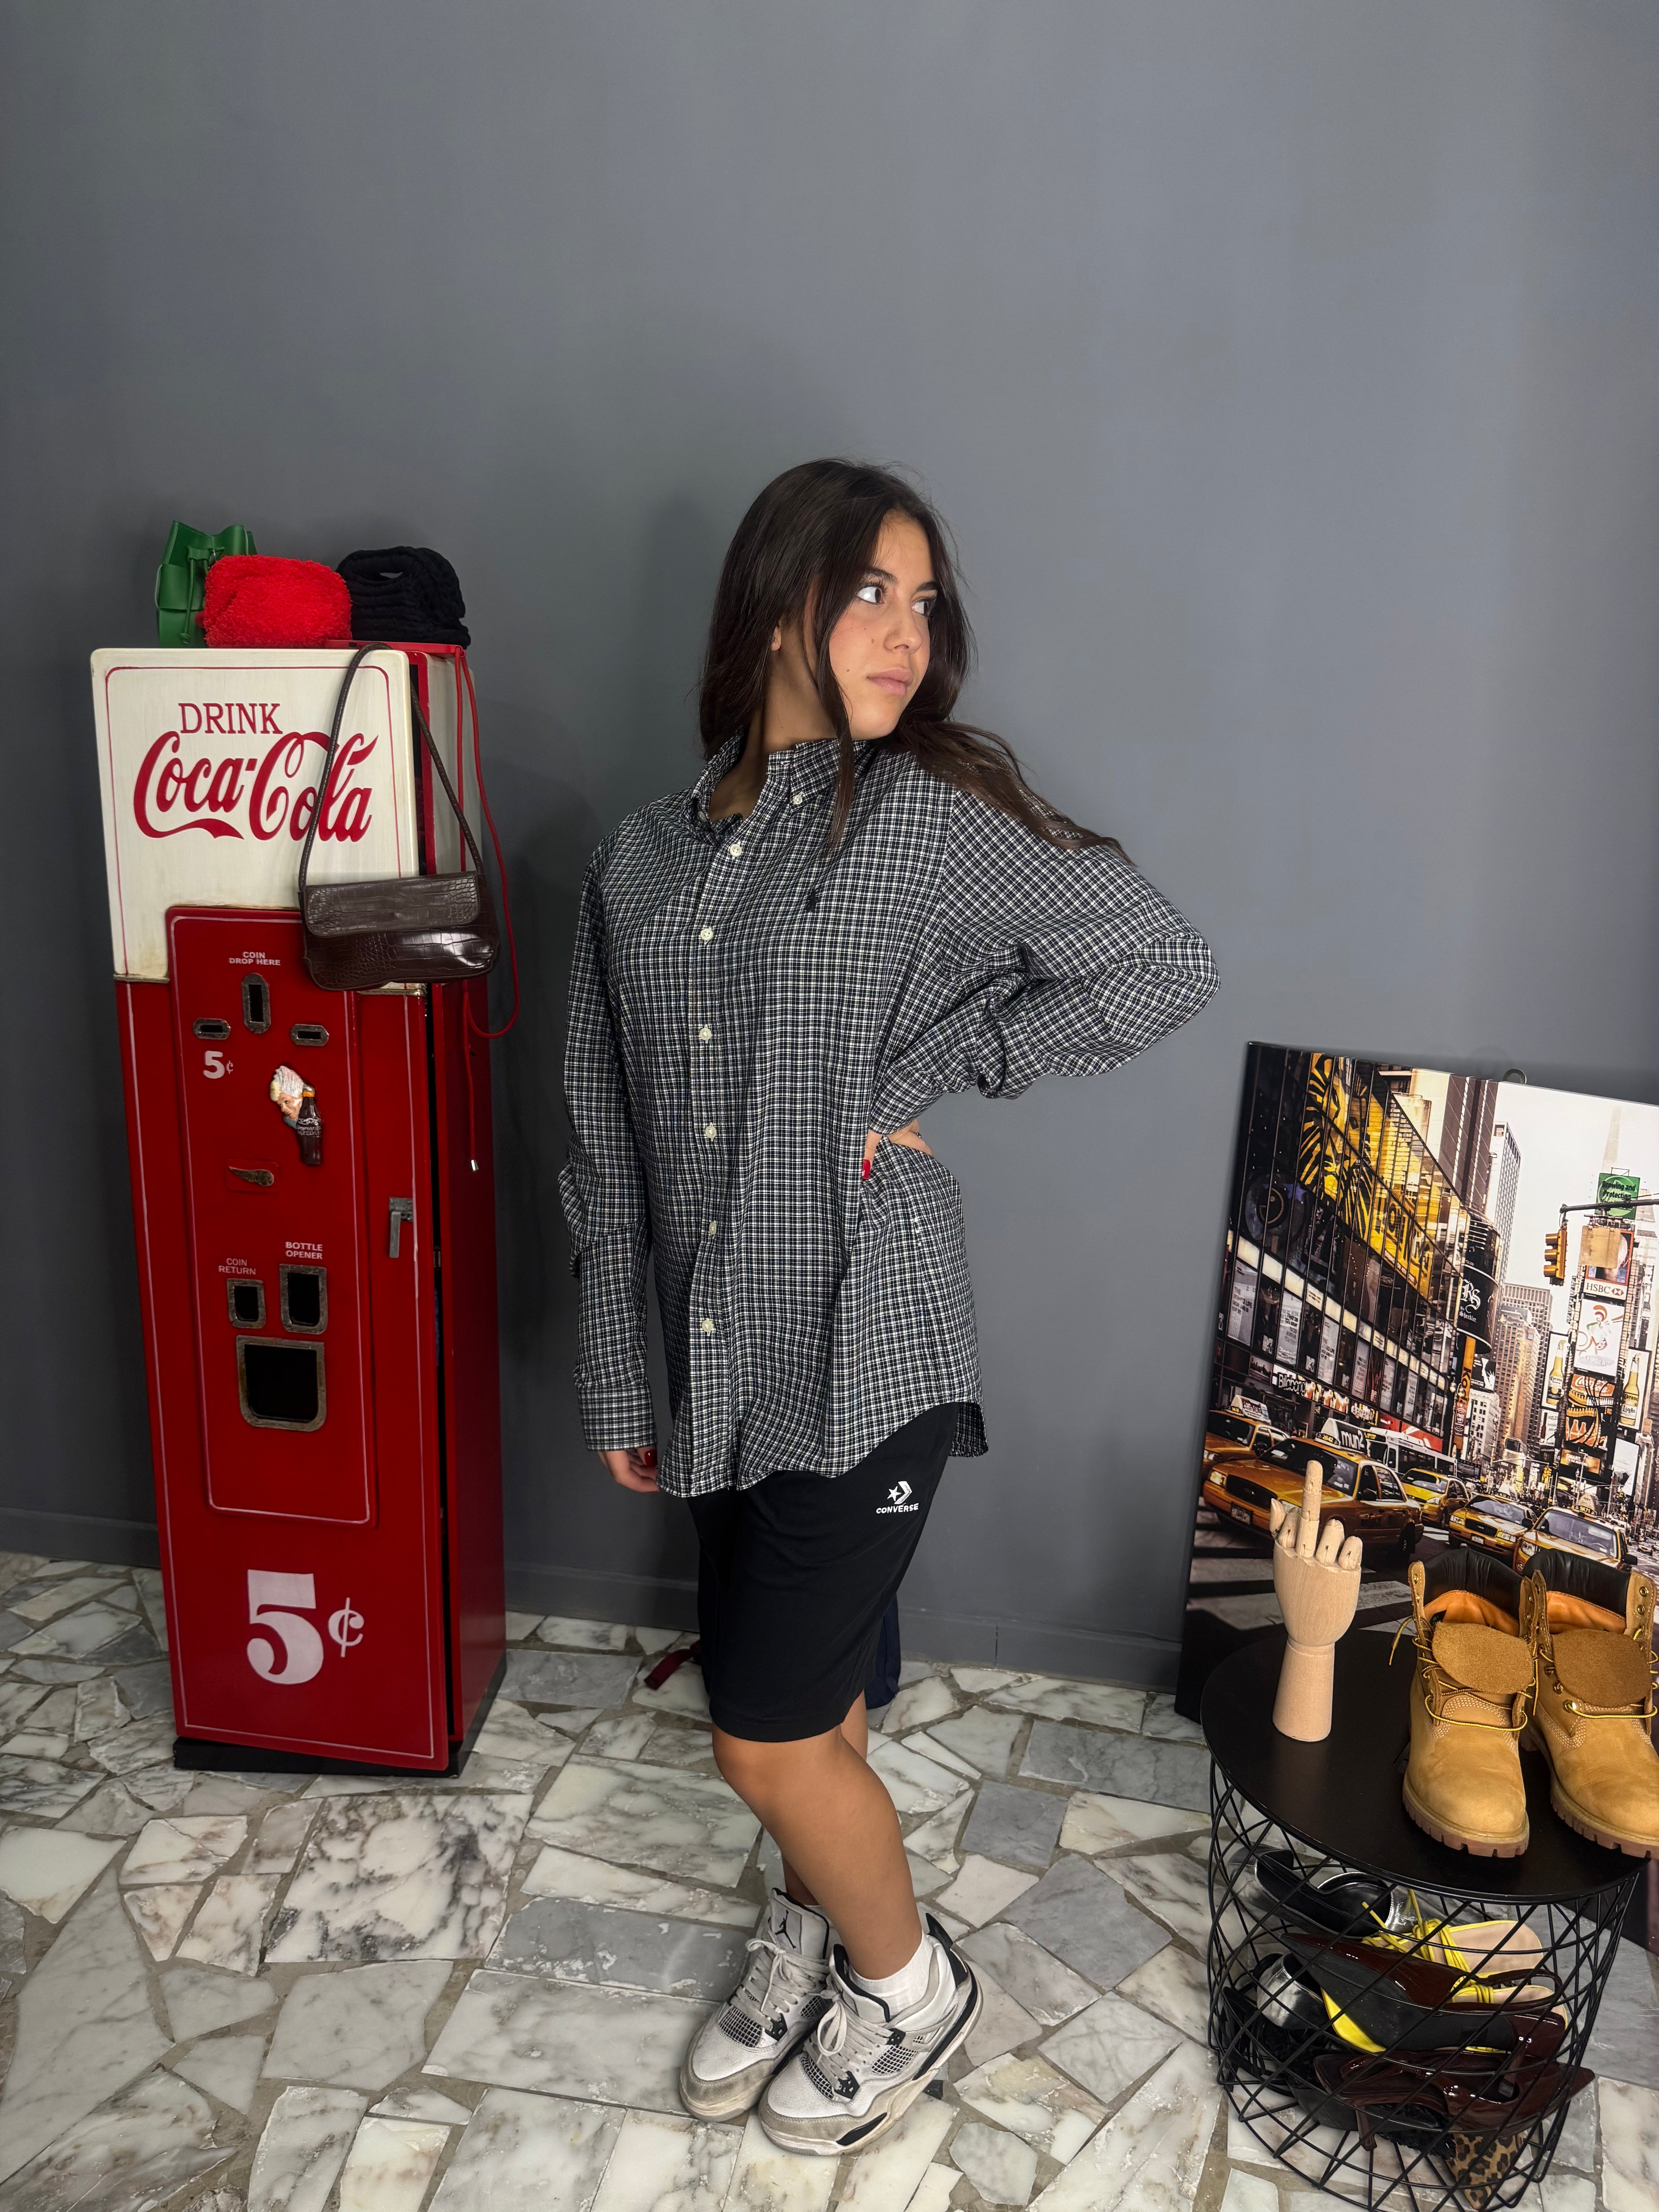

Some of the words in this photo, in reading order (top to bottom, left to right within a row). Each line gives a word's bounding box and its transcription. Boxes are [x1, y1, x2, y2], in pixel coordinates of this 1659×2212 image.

[178, 702, 283, 734] DRINK
[133, 730, 379, 842] Coca-Cola
[285, 1241, 323, 1251] BOTTLE
[285, 1250, 323, 1260] OPENER
[226, 1258, 248, 1266] COIN
[218, 1265, 256, 1274] RETURN
[1586, 1282, 1611, 1294] HSBC
[876, 1503, 919, 1514] CONVERSE
